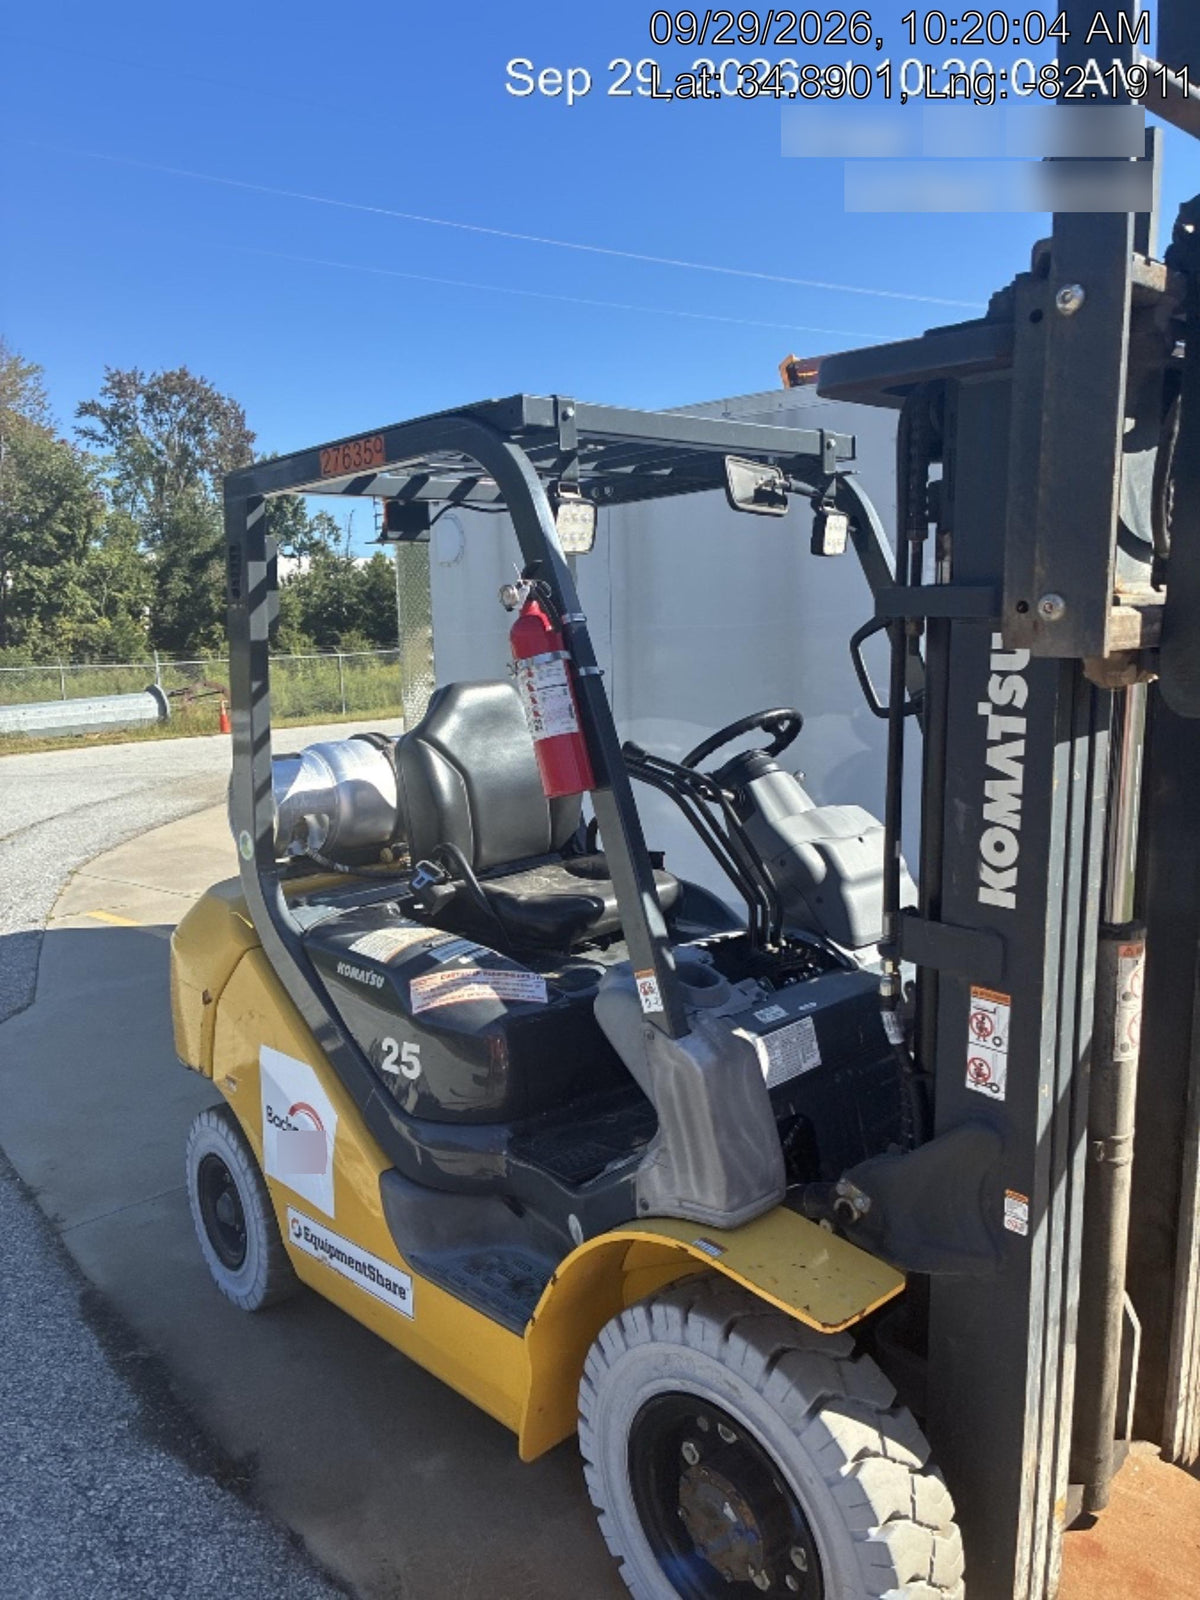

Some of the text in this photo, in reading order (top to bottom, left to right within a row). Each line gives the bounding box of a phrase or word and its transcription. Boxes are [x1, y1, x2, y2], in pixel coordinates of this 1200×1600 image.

[977, 632, 1031, 909] KOMATSU
[336, 961, 385, 989] KOMATSU
[381, 1036, 423, 1081] 25
[303, 1225, 407, 1301] EquipmentShare
